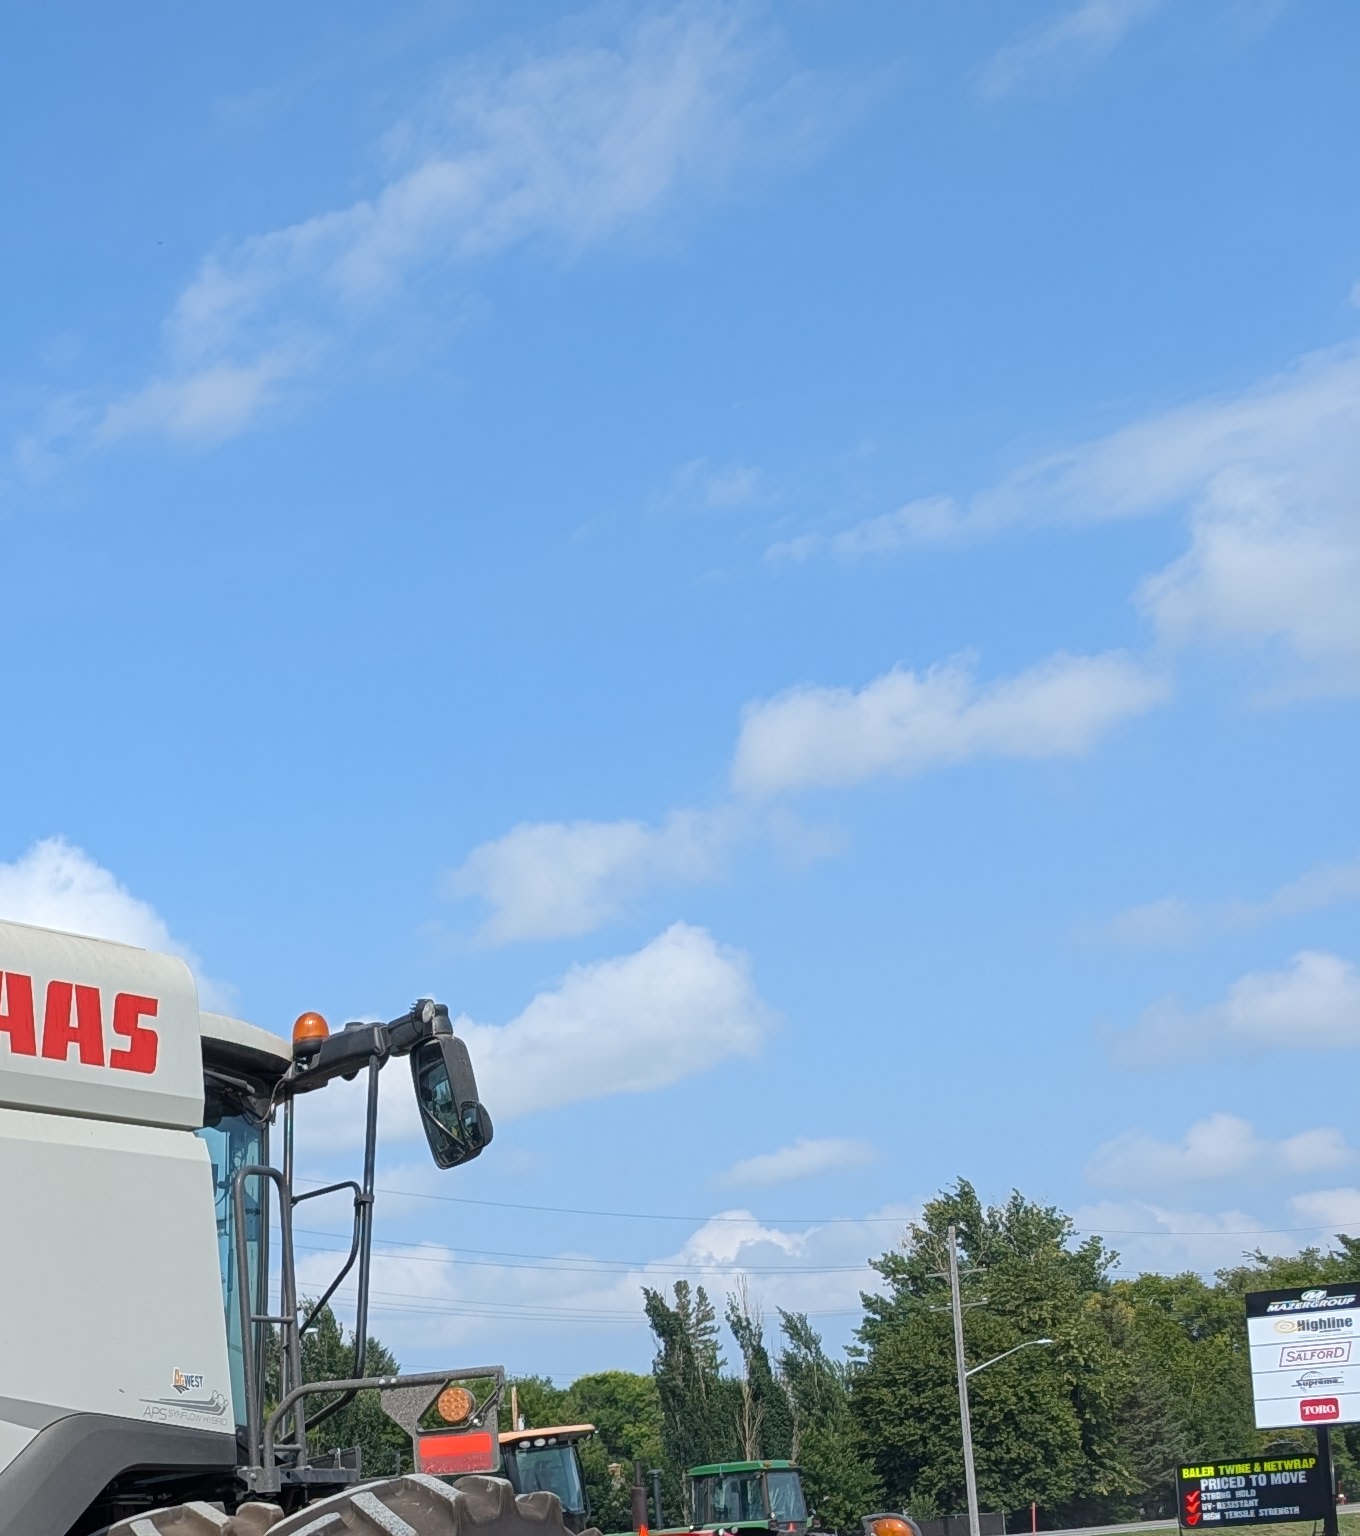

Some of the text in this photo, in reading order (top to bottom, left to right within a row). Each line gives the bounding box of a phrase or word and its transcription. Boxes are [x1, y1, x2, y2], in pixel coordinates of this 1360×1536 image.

[1266, 1297, 1356, 1312] MAZERGROUP
[1297, 1317, 1353, 1332] Highline
[143, 1405, 167, 1421] APS
[1182, 1466, 1214, 1478] BALER
[1218, 1463, 1252, 1475] TWINE
[1264, 1458, 1316, 1471] NETWRAP
[1200, 1471, 1307, 1491] PRICED TO MOVE
